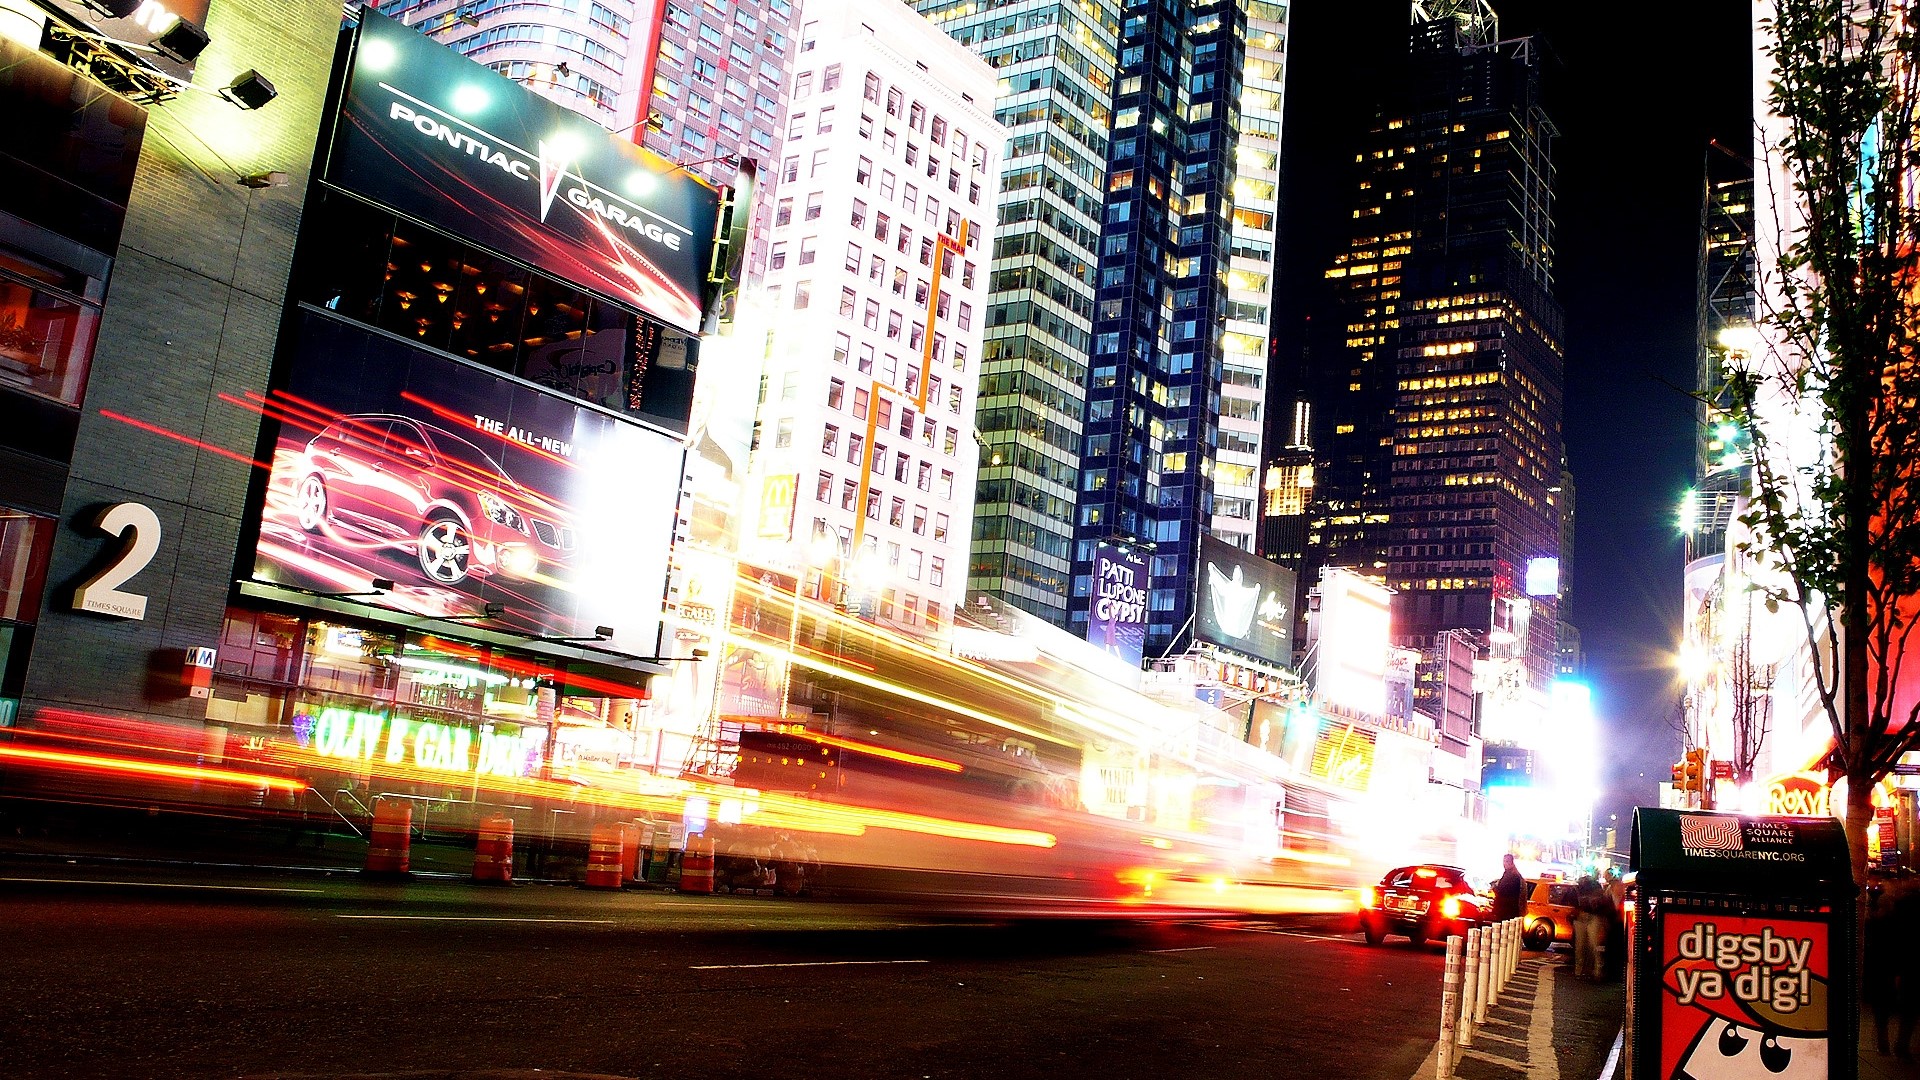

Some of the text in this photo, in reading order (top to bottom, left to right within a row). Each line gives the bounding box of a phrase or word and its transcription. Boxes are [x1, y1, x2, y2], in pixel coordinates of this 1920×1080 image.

[389, 101, 682, 252] PONTIAC GARAGE
[474, 414, 504, 436] THE
[507, 425, 574, 457] ALL-NEW
[81, 502, 162, 620] 2
[1098, 558, 1135, 586] PATTI
[1097, 577, 1147, 606] LUPONE
[86, 600, 143, 618] TIMES SQUARE
[1095, 598, 1145, 624] GYPSY
[1746, 828, 1795, 838] SQUARE
[1750, 821, 1789, 830] TIMES
[1750, 836, 1793, 845] ALLIANCE
[1682, 847, 1806, 863] TIMESSQUARENYC.ORG
[1679, 923, 1811, 973] digsby
[1676, 966, 1811, 1013] ya dig!
